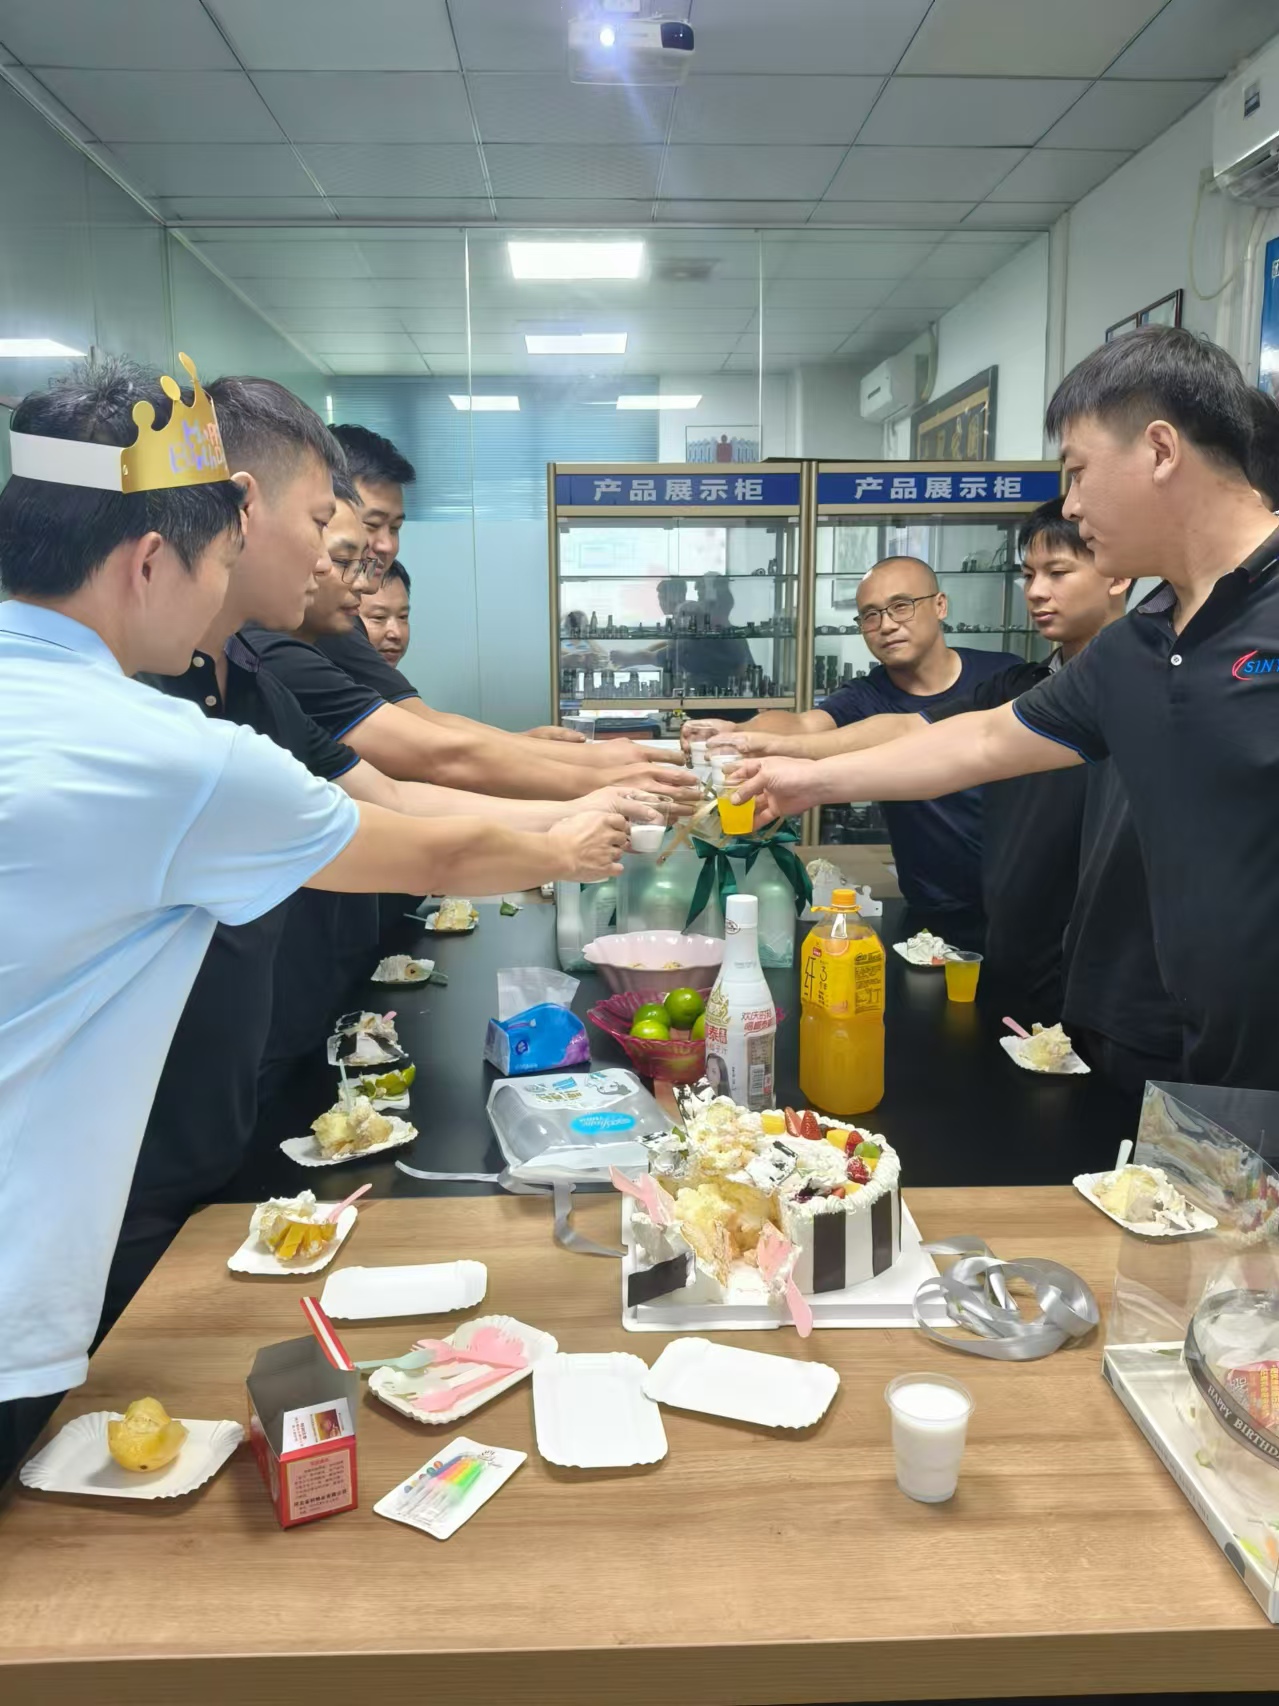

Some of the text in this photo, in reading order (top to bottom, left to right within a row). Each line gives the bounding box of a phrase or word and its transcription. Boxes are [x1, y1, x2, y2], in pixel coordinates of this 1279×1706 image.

[593, 478, 763, 502] 产品展示柜
[854, 476, 1022, 500] 产品展示柜
[1207, 1385, 1232, 1418] HAPPY
